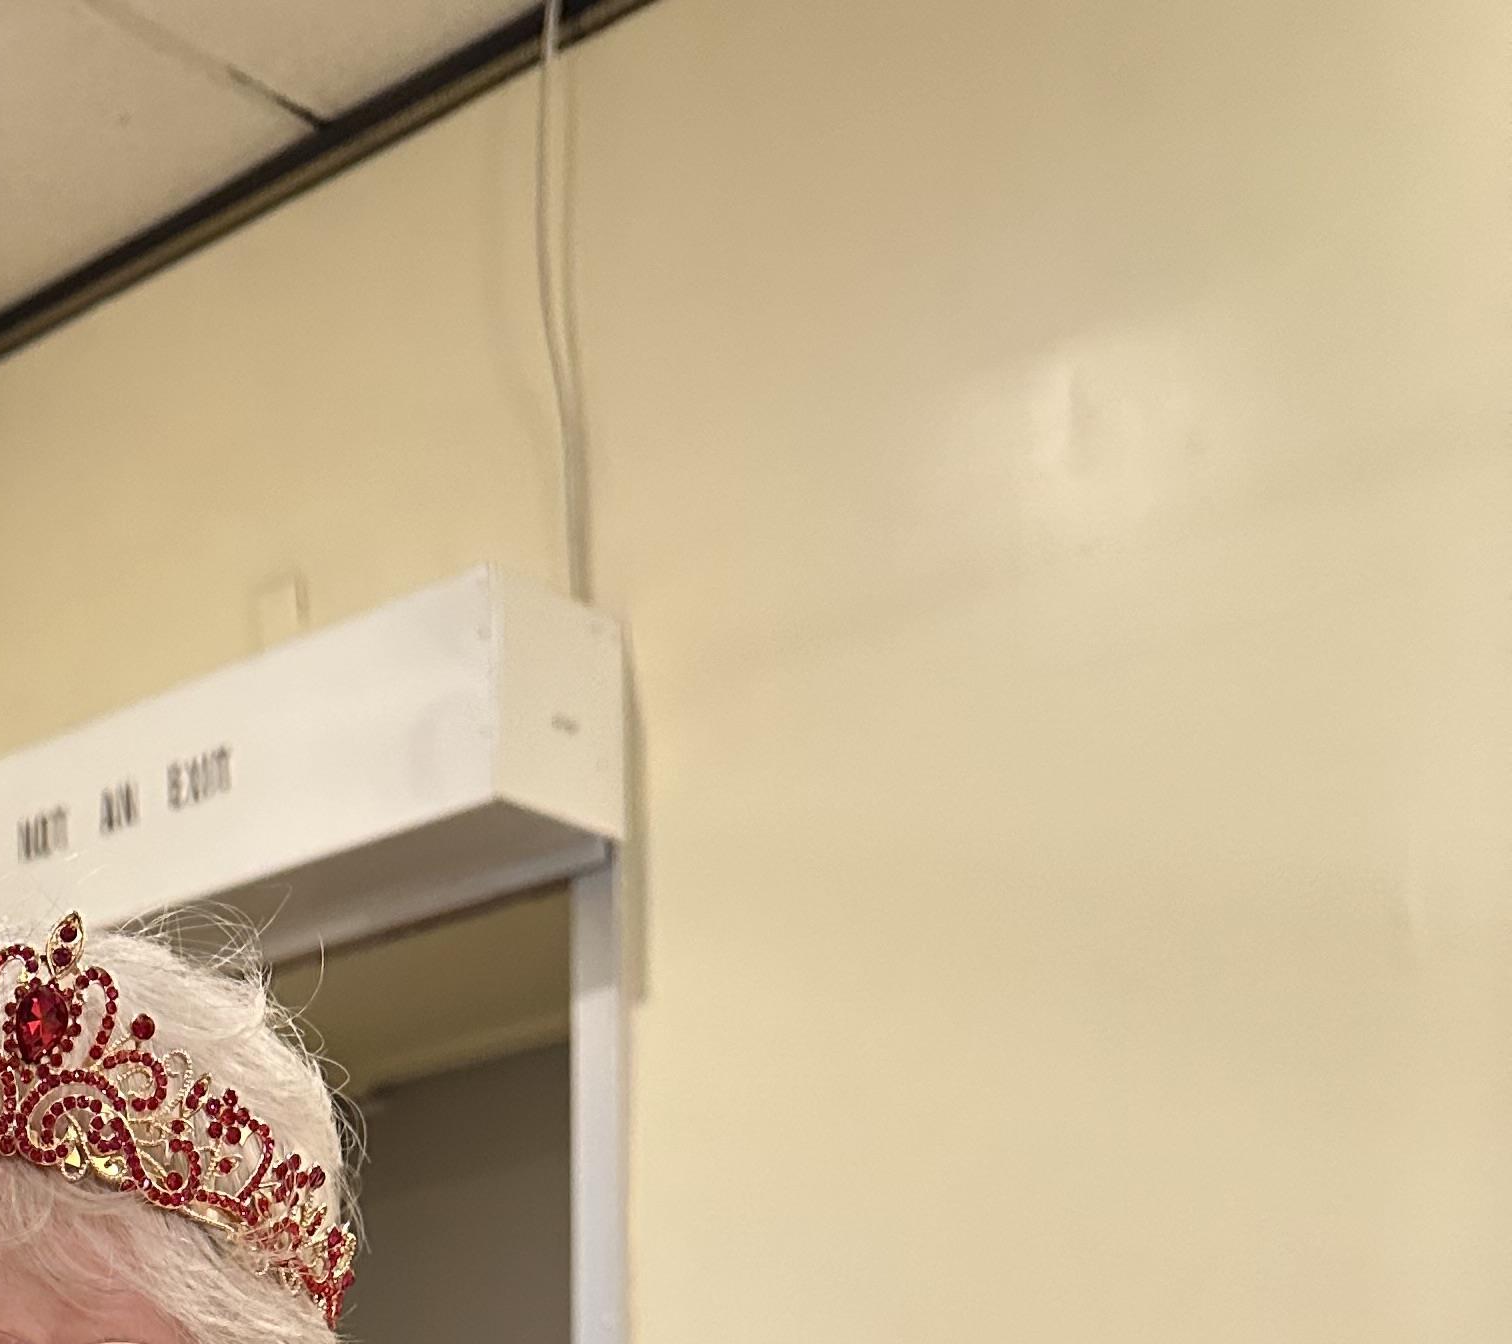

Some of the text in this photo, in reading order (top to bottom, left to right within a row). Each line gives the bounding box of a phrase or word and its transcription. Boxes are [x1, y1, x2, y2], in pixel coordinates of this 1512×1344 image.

[15, 744, 233, 863] NOT AN EXIT
